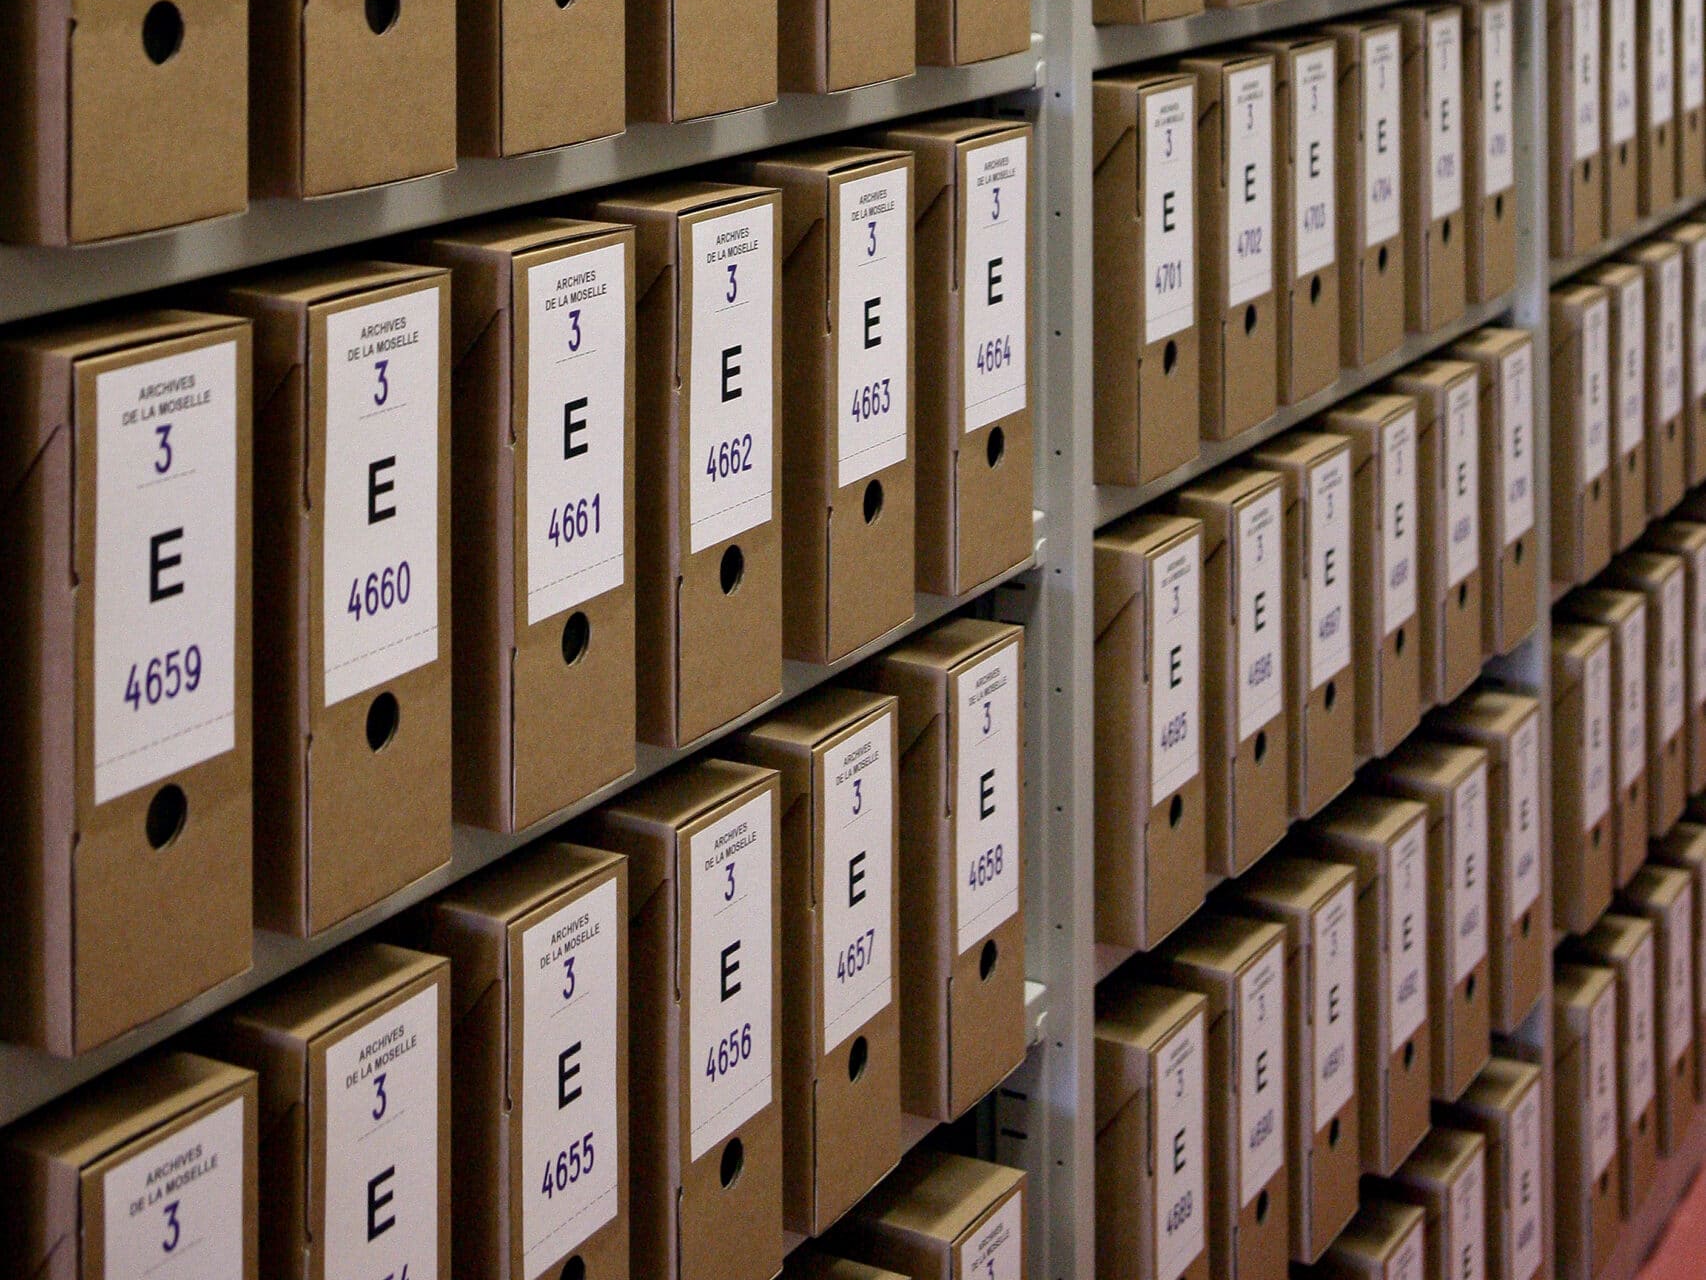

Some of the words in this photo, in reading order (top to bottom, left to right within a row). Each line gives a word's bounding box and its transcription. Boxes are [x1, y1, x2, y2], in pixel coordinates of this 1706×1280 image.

[1377, 118, 1387, 154] E
[1441, 99, 1450, 133] E
[1165, 128, 1173, 157] 3
[1309, 141, 1320, 179] E
[991, 187, 1001, 220] 3
[1244, 163, 1256, 203] E
[1163, 191, 1176, 233] E
[867, 221, 877, 257] 3
[1237, 227, 1262, 256] 4702
[545, 297, 556, 311] DE
[558, 295, 569, 308] LA
[570, 283, 607, 303] MOSELLE
[556, 270, 596, 291] ARCHIVES
[726, 264, 738, 303] 3
[987, 257, 1004, 306] E
[1155, 261, 1182, 294] 4701
[361, 316, 406, 338] ARCHIVES
[568, 309, 581, 352] 3
[864, 297, 882, 349] E
[347, 347, 360, 362] DE
[362, 344, 374, 358] LA
[376, 331, 419, 353] MOSELLE
[976, 335, 1011, 374] 4664
[374, 360, 388, 406] 3
[721, 345, 742, 403] E
[852, 378, 890, 422] 4663
[155, 424, 172, 474] 3
[564, 397, 588, 460] E
[706, 433, 752, 482] 4662
[368, 456, 396, 525] E
[548, 493, 600, 547] 4661
[149, 528, 184, 603] E
[1325, 548, 1335, 587] E
[348, 561, 411, 621] 4660
[1254, 591, 1266, 632] E
[124, 645, 202, 710] 4659
[1170, 645, 1182, 689] E
[982, 701, 992, 734] 3
[852, 779, 862, 815] 3
[979, 768, 996, 821] E
[724, 862, 735, 901] 3
[849, 851, 866, 908] E
[968, 843, 1003, 889] 4658
[540, 953, 551, 969] DE
[552, 946, 563, 961] LA
[564, 923, 600, 954] MOSELLE
[551, 913, 589, 945] ARCHIVES
[720, 940, 741, 1002] E
[837, 928, 874, 983] 4657
[563, 956, 575, 1000] 3
[706, 1023, 752, 1082] 4656
[1256, 1049, 1268, 1093] E
[372, 1072, 387, 1121] 3
[558, 1041, 582, 1110] E
[542, 1132, 594, 1199] 4655
[1174, 1127, 1186, 1174] E
[367, 1164, 396, 1243] E
[162, 1199, 180, 1253] 3
